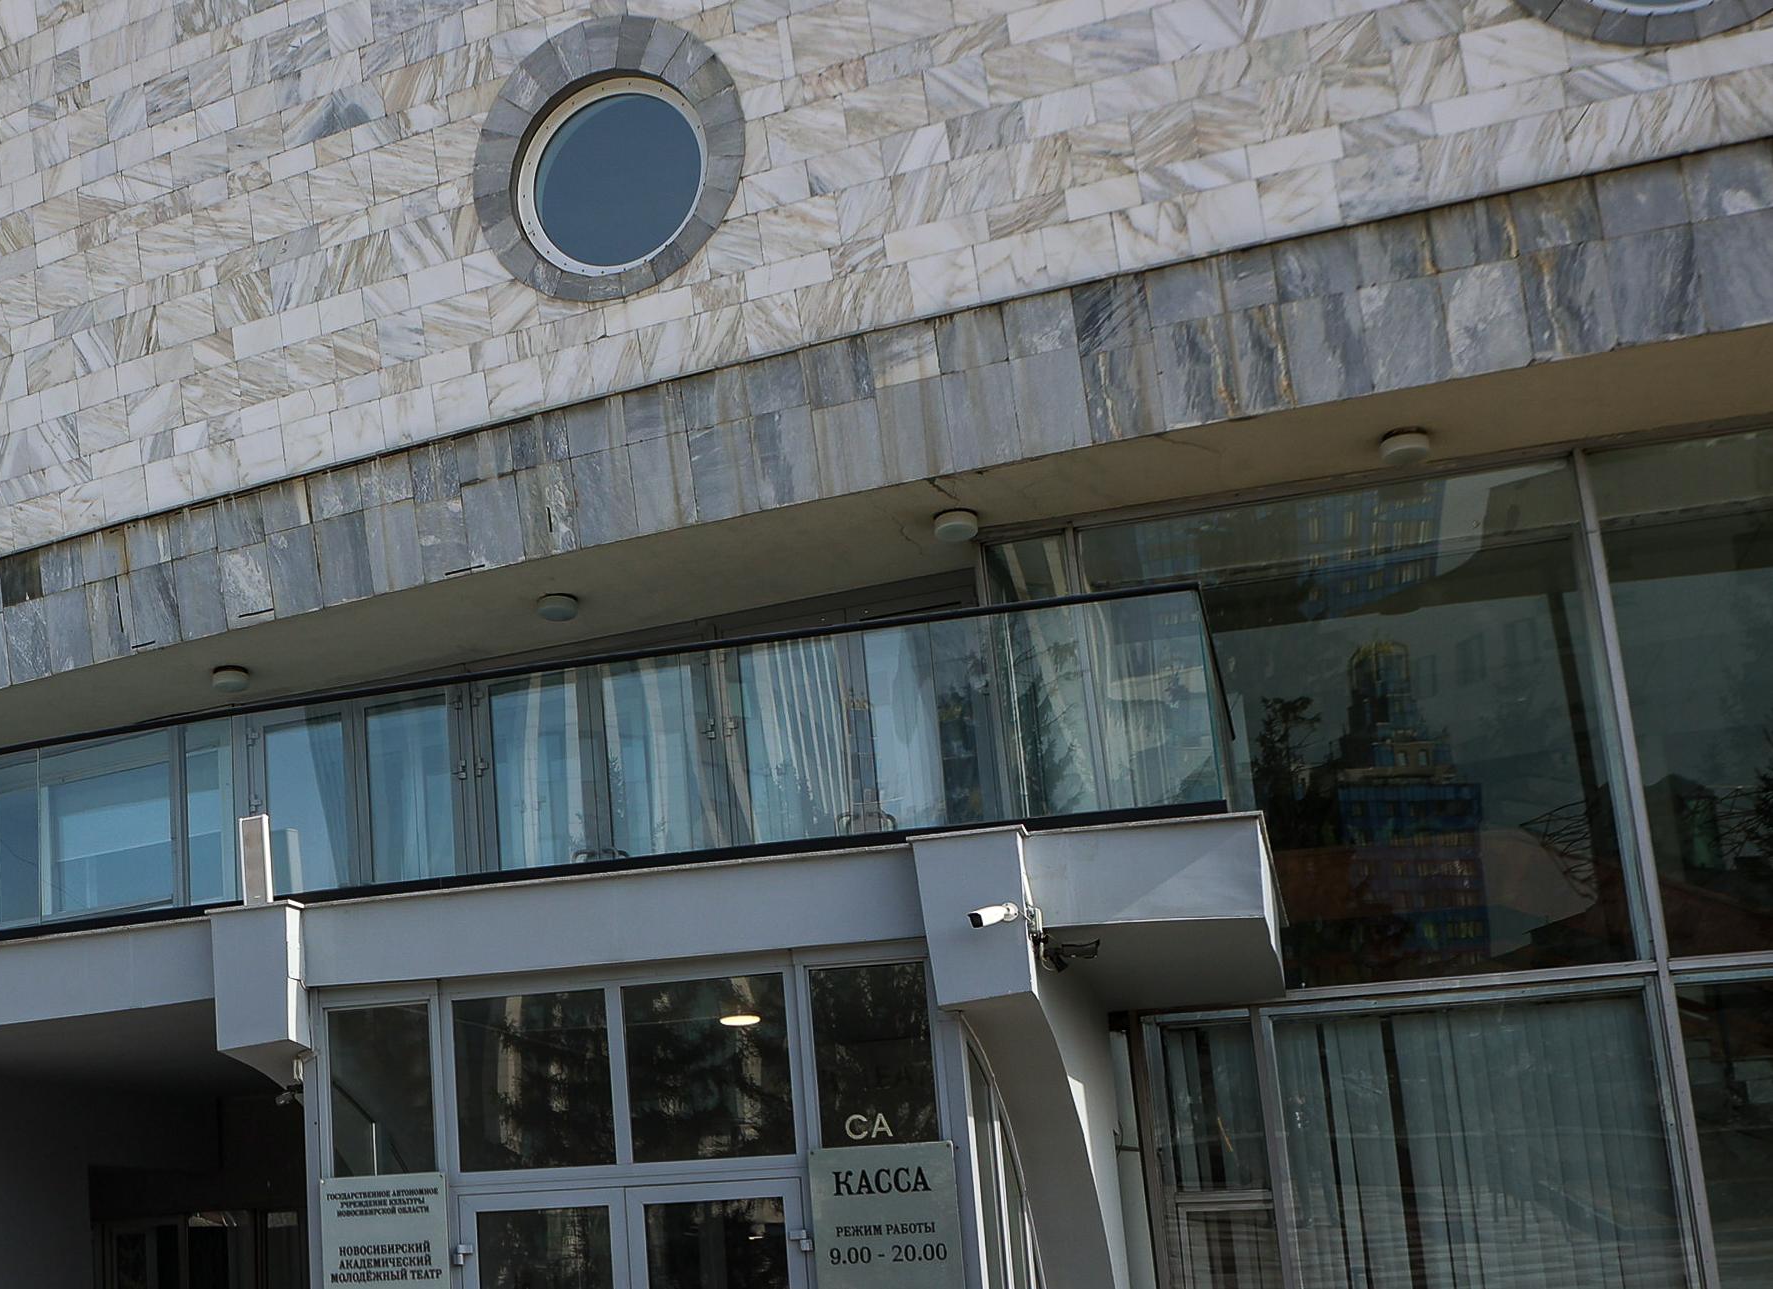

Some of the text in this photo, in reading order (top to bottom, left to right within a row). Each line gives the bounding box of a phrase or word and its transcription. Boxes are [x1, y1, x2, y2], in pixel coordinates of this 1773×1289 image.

[832, 1166, 932, 1196] КАССА
[326, 1187, 439, 1200] ГОСУДАРСТВЕННОЕ АВТОНОМНОЕ
[397, 1205, 429, 1215] ОБЛАСТИ
[835, 1221, 936, 1238] РЕЖИМ РАБОТЫ
[338, 1240, 431, 1257] НОВОСИБИРСКИЙ
[829, 1246, 872, 1266] 9.00
[891, 1242, 948, 1262] 20.00
[338, 1254, 432, 1270] АКАДЕМИЧЕСКИЙ
[330, 1268, 443, 1284] МОЛОДЁЖНЫЙ ТЕАТР
